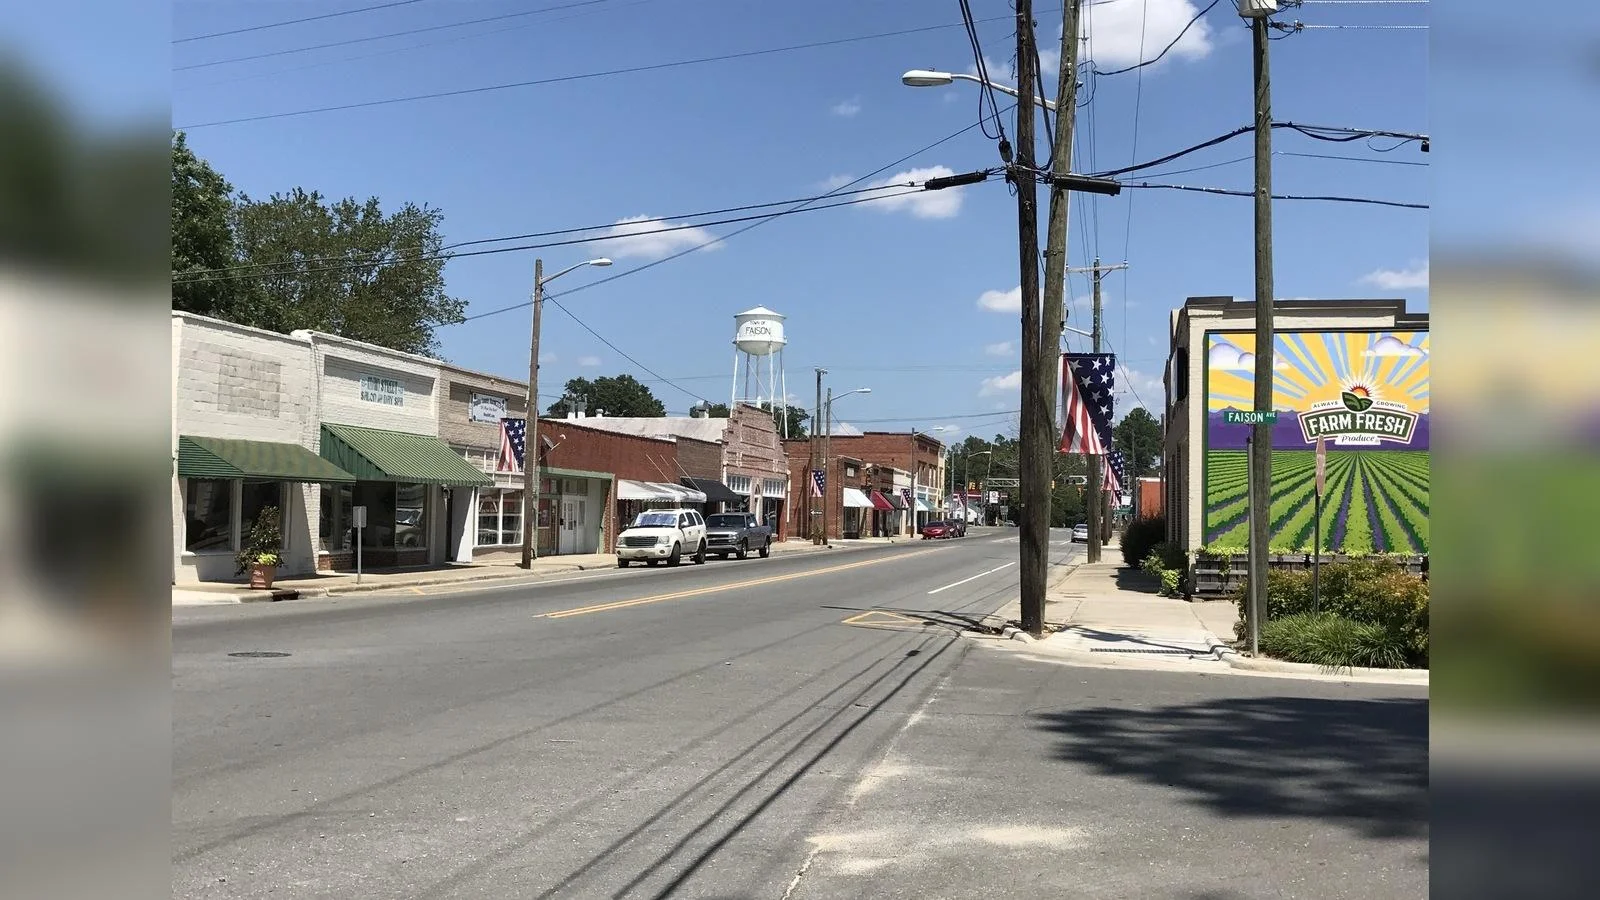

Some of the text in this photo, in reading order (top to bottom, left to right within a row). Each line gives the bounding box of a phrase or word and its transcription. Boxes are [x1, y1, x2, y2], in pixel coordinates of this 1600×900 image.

[746, 326, 771, 335] FAISON
[380, 378, 398, 394] STREET
[1376, 400, 1406, 410] GROWING
[1228, 412, 1264, 422] FAISON
[1308, 413, 1407, 435] FARM FRESH
